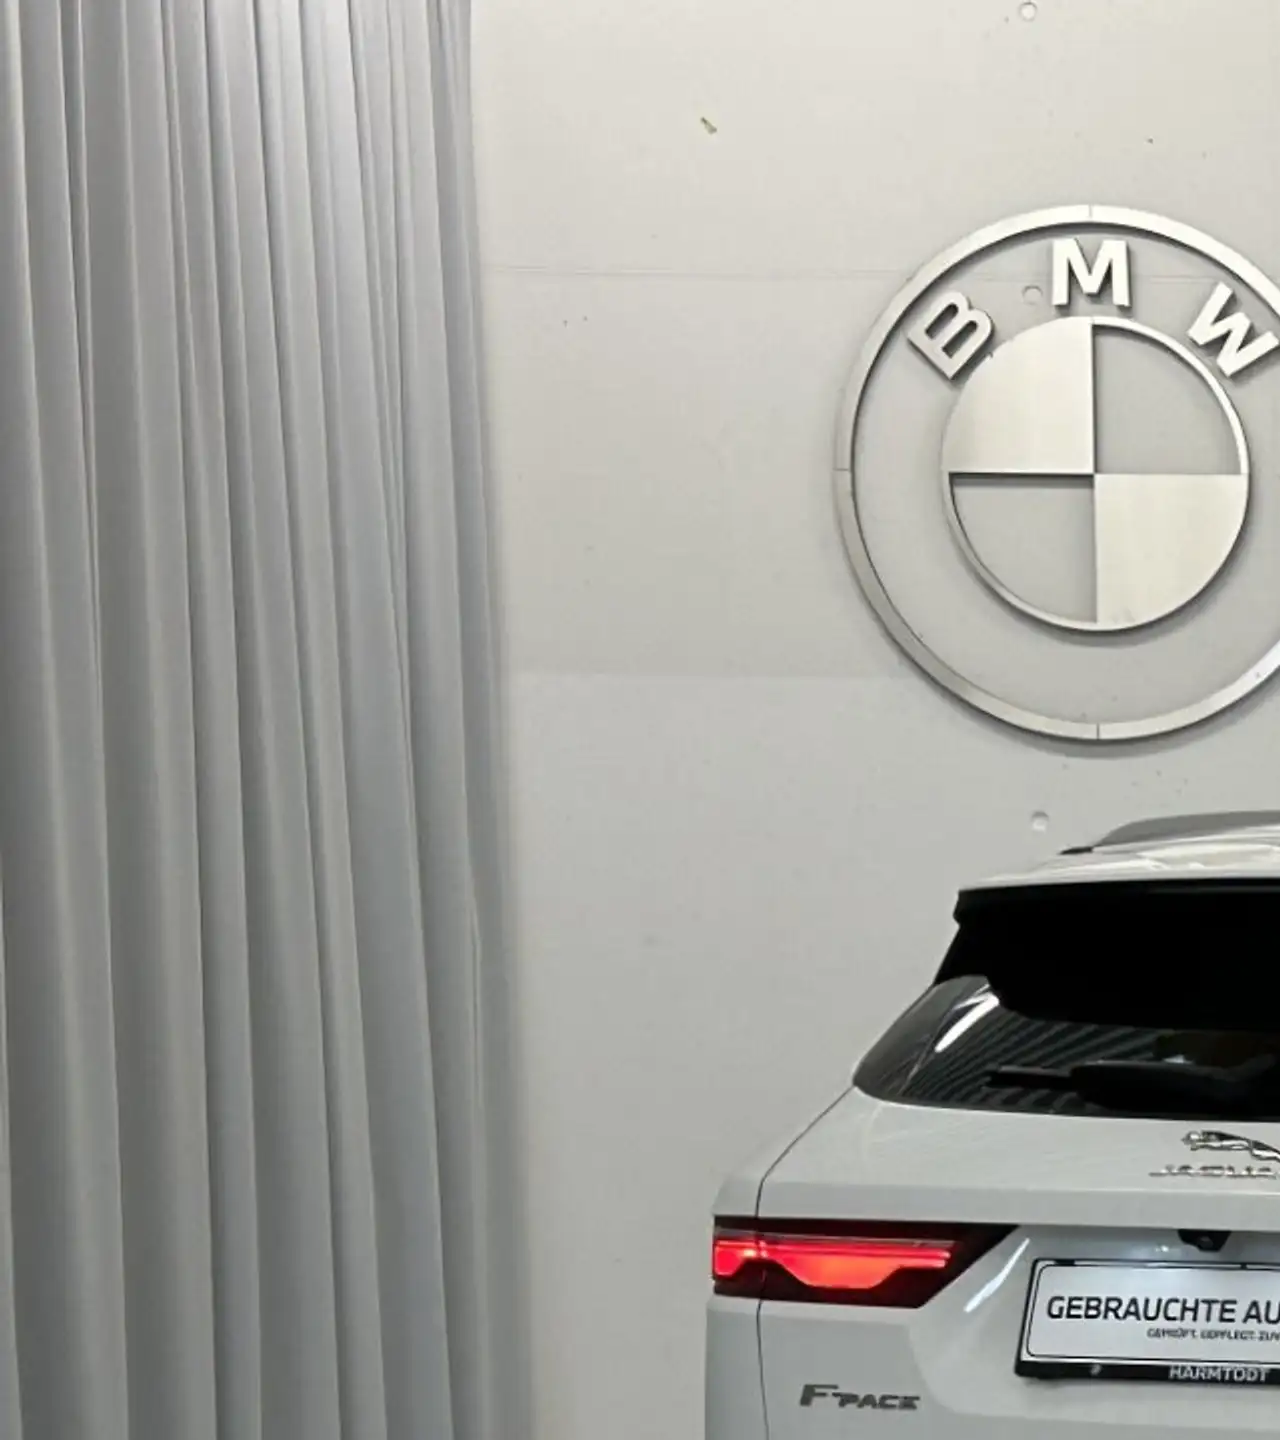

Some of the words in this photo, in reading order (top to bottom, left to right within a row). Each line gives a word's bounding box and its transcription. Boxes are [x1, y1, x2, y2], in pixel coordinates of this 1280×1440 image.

[906, 238, 1280, 379] BMW
[1046, 1295, 1236, 1323] GEBRAUCHTE
[1168, 1365, 1270, 1383] HARMTODT
